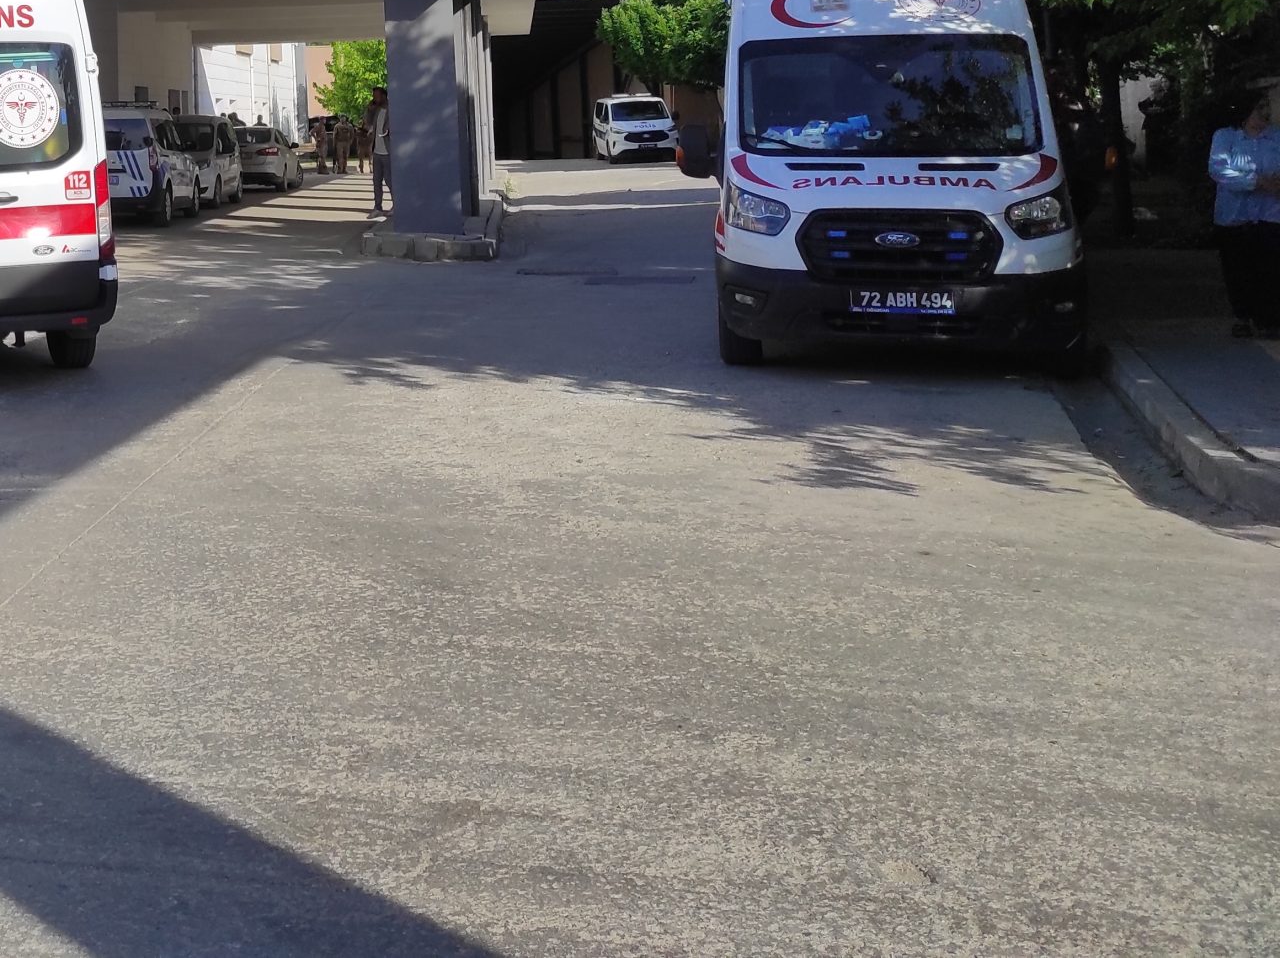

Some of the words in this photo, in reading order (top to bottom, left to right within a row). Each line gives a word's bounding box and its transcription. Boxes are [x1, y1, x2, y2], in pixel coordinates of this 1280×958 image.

[67, 173, 88, 188] 112
[860, 291, 881, 307] 72
[886, 292, 917, 308] ABH
[920, 292, 952, 309] 494
